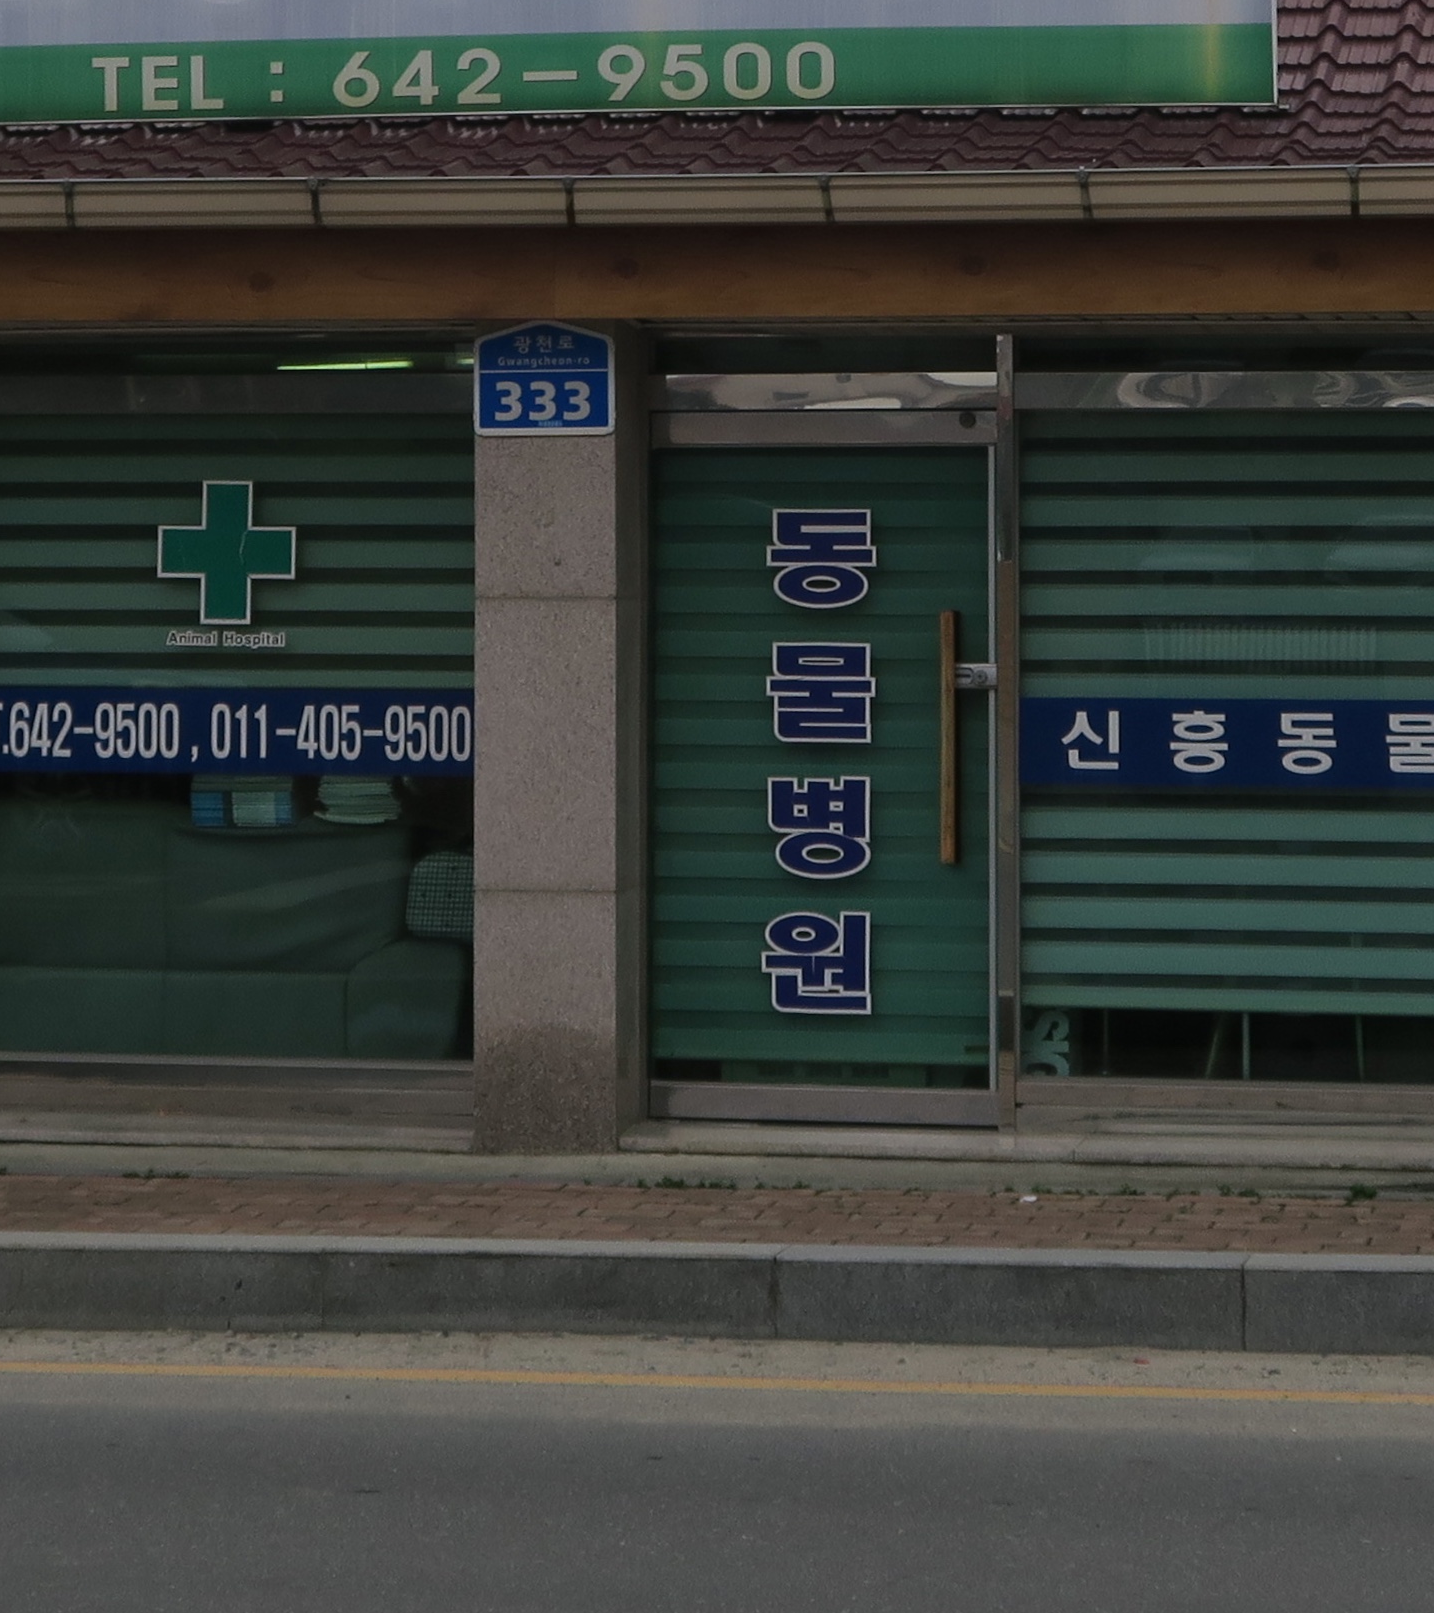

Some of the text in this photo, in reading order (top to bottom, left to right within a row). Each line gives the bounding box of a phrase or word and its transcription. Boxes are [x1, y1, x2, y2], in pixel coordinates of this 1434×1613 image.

[92, 55, 224, 112] TEL
[332, 41, 835, 108] 642-9500
[497, 355, 590, 368] Gwangcheon-ro
[513, 335, 574, 354] 광천로
[494, 381, 591, 421] 333
[168, 632, 284, 648] Animal Hospital
[210, 703, 471, 763] 011-405-9500
[761, 508, 877, 1015] 동물병원
